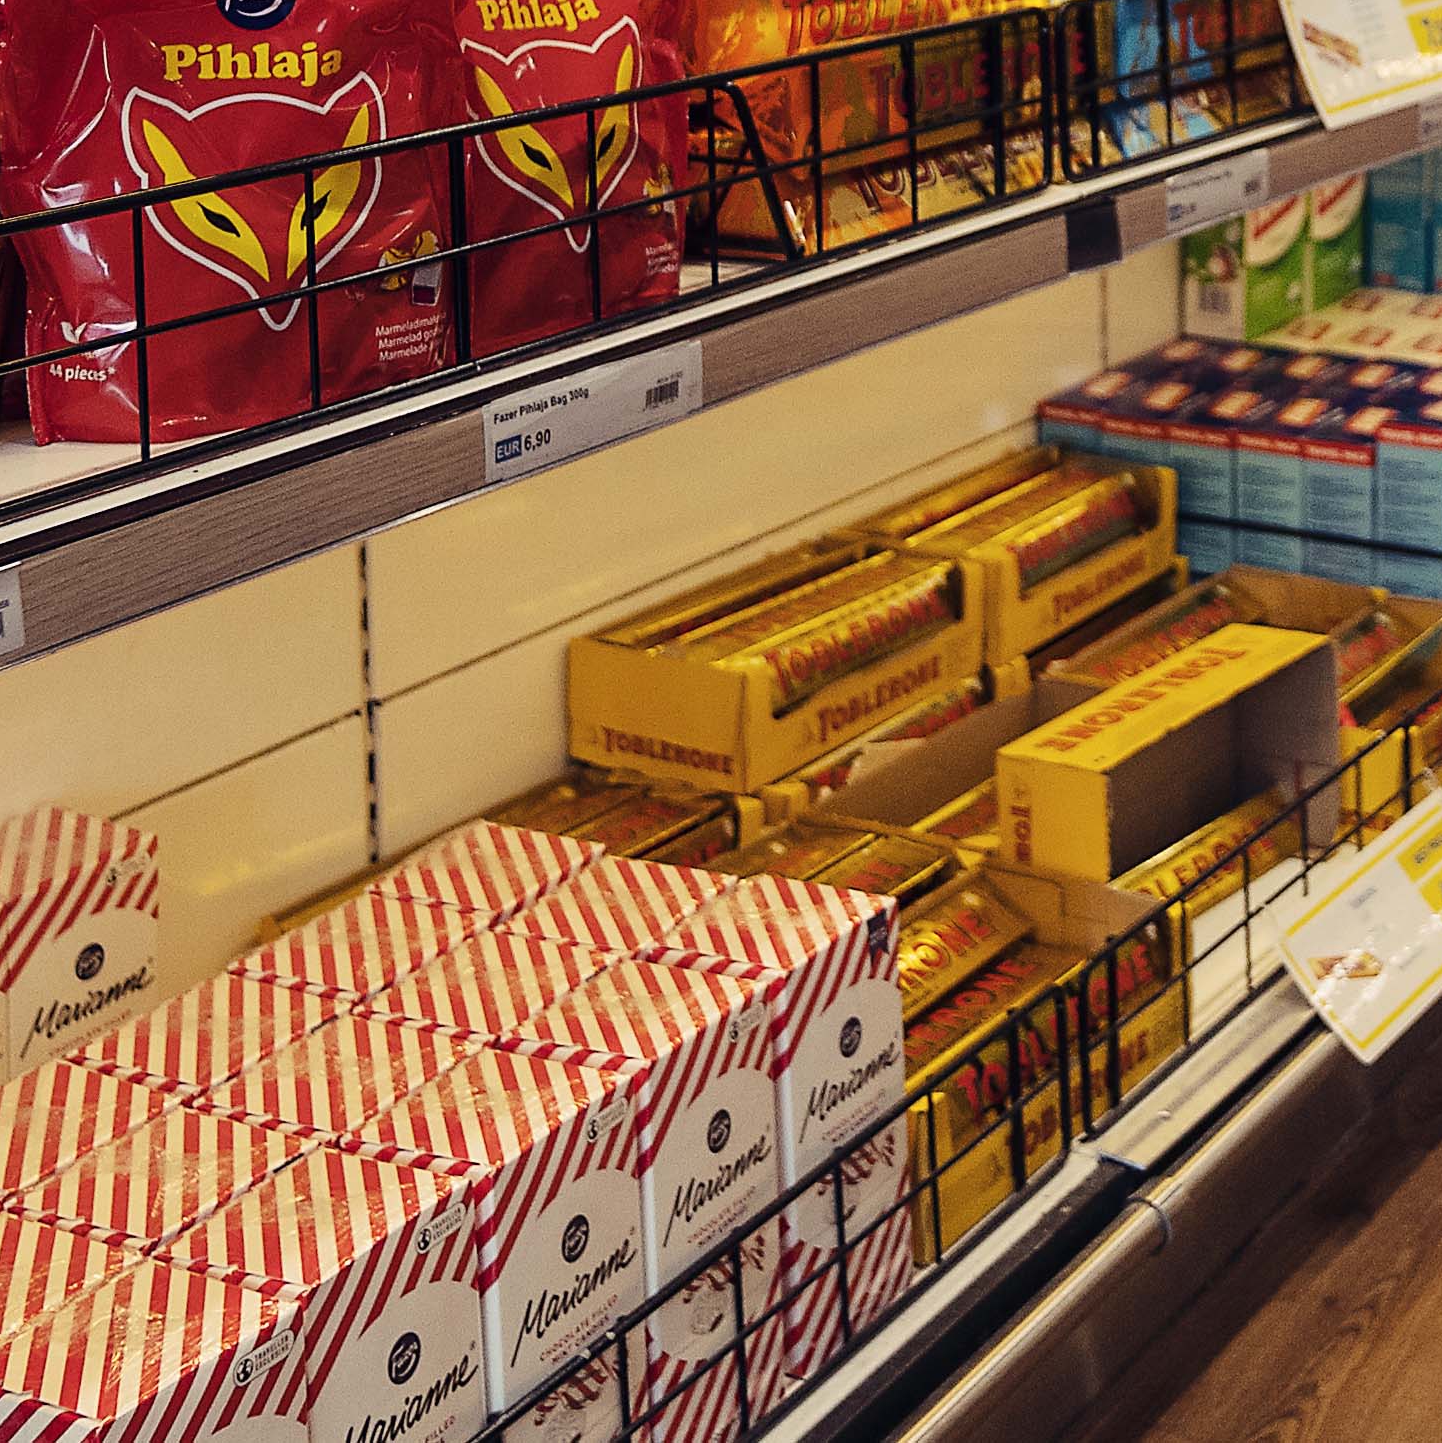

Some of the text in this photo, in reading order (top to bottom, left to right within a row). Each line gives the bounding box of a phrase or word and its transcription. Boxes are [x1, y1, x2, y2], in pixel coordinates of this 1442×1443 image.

[163, 42, 344, 88] Pihlaja
[494, 386, 590, 425] Fazer Pihlaja Bag 300g
[496, 428, 552, 460] EUR 6,90
[662, 1131, 773, 1249] Marianne
[510, 1236, 640, 1369] Marianne
